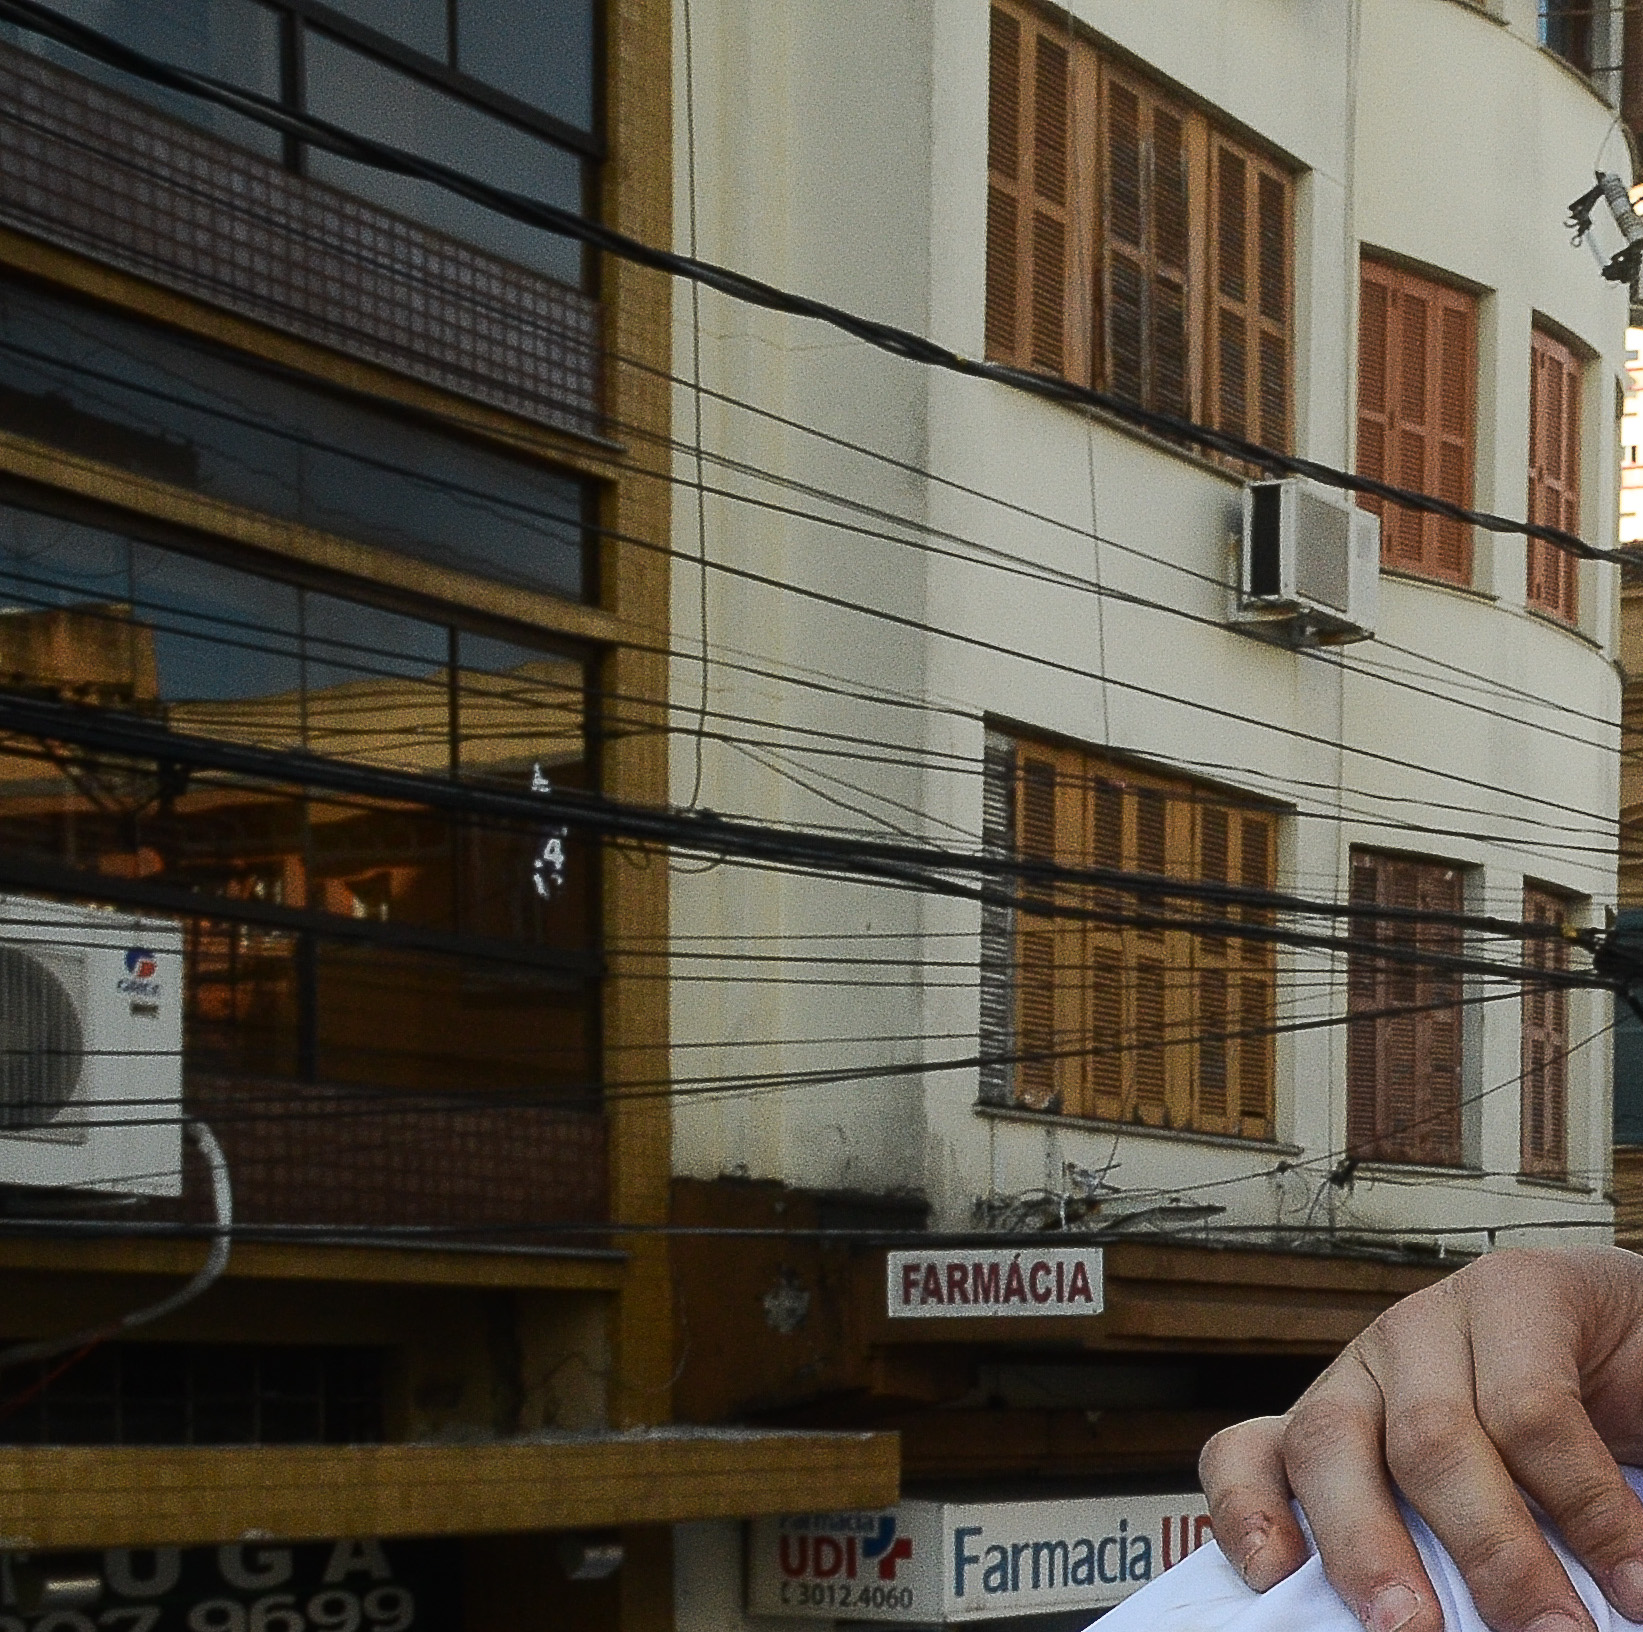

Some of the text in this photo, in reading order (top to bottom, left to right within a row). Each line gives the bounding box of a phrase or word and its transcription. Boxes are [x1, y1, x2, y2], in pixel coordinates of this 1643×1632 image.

[902, 1252, 1094, 1305] FARMÁCIA
[779, 1534, 858, 1581] UDI
[953, 1518, 1152, 1597] Farmacia
[798, 1582, 914, 1609] 3012.4060
